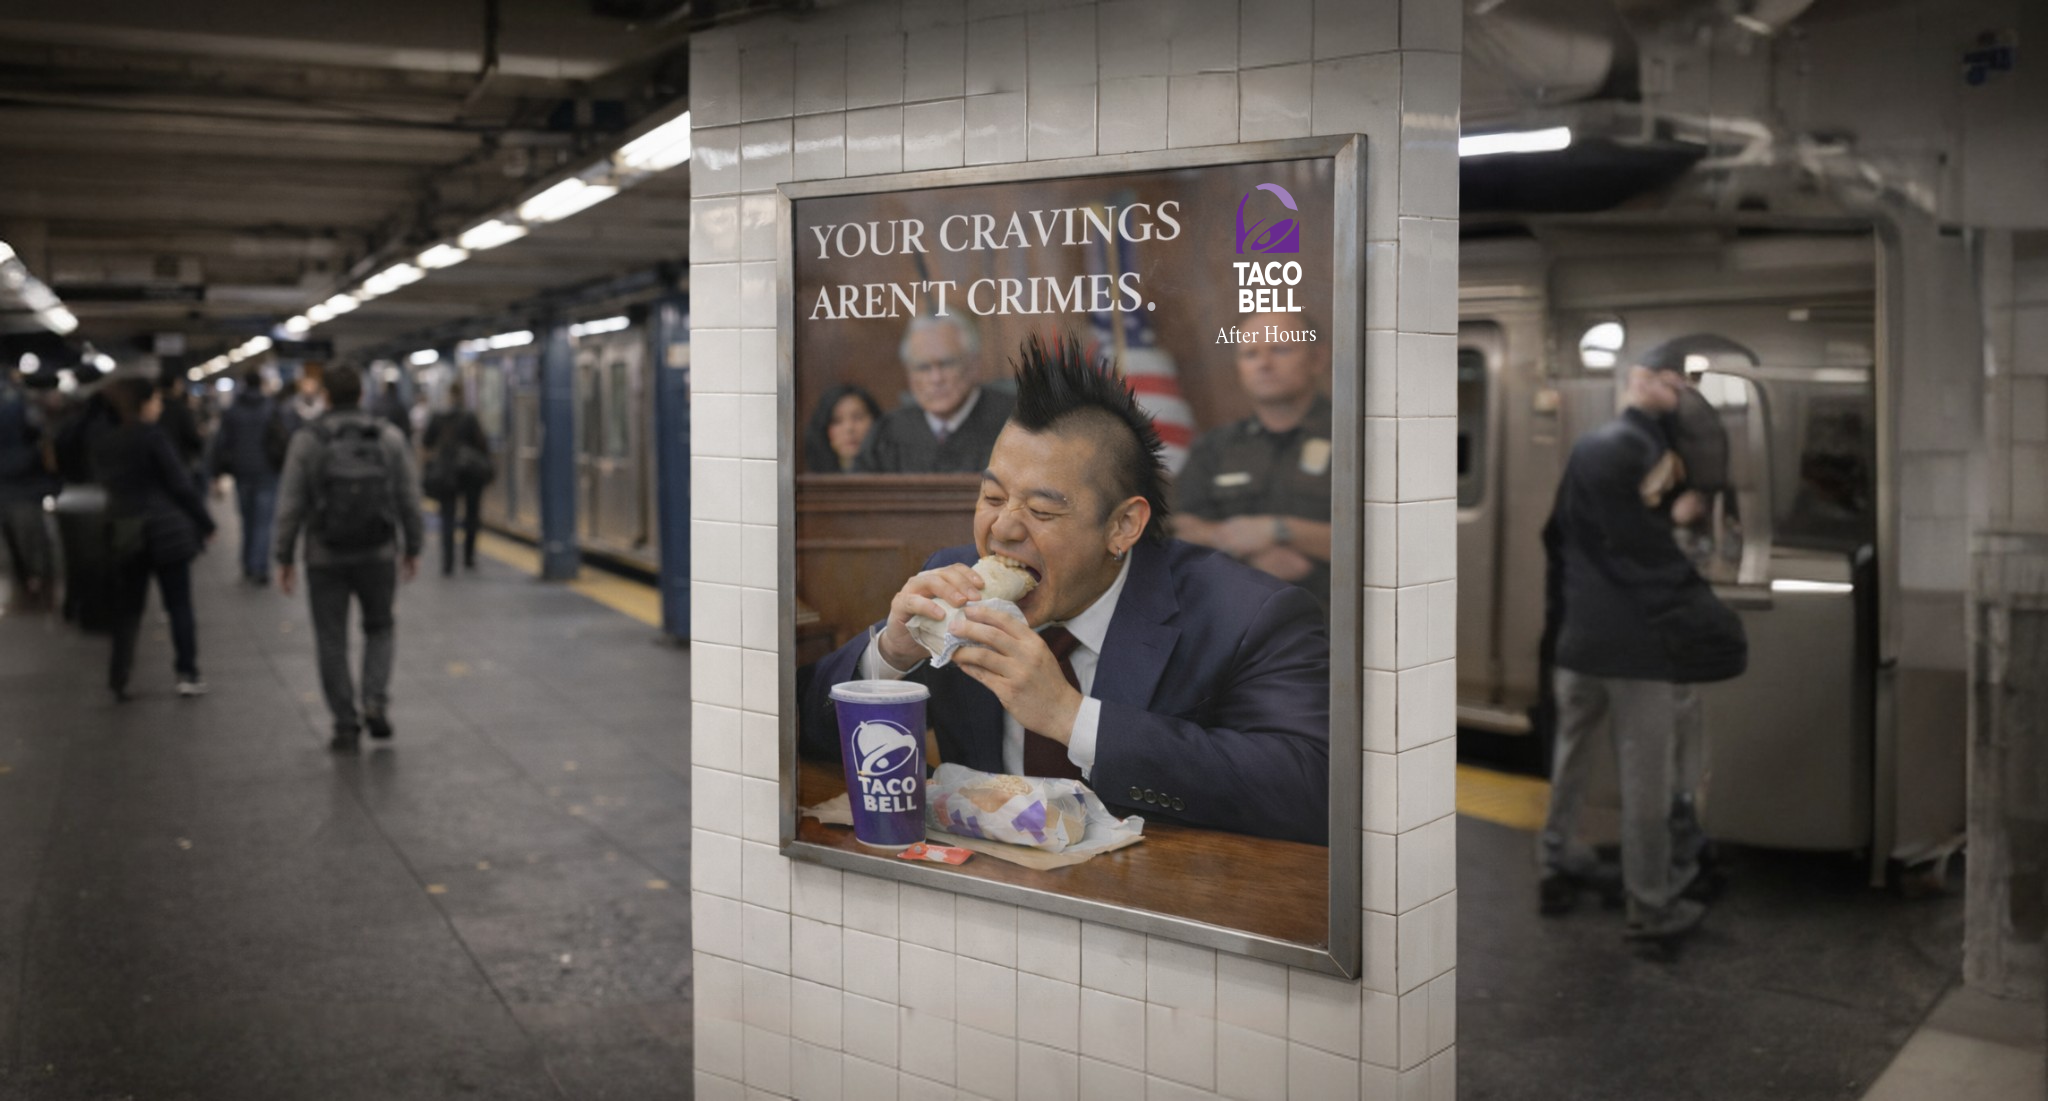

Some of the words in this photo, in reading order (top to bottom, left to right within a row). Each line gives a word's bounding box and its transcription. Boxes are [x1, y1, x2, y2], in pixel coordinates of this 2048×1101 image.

[810, 219, 928, 259] YOUR
[939, 200, 1181, 253] CRAVINGS
[1233, 260, 1303, 287] TACO
[809, 279, 957, 320] AREN'T
[967, 271, 1156, 316] CRIMES.
[1238, 288, 1302, 313] BELL
[1215, 325, 1260, 344] After
[1264, 324, 1317, 343] Hours
[858, 776, 917, 794] TACO
[863, 794, 917, 812] BELL
